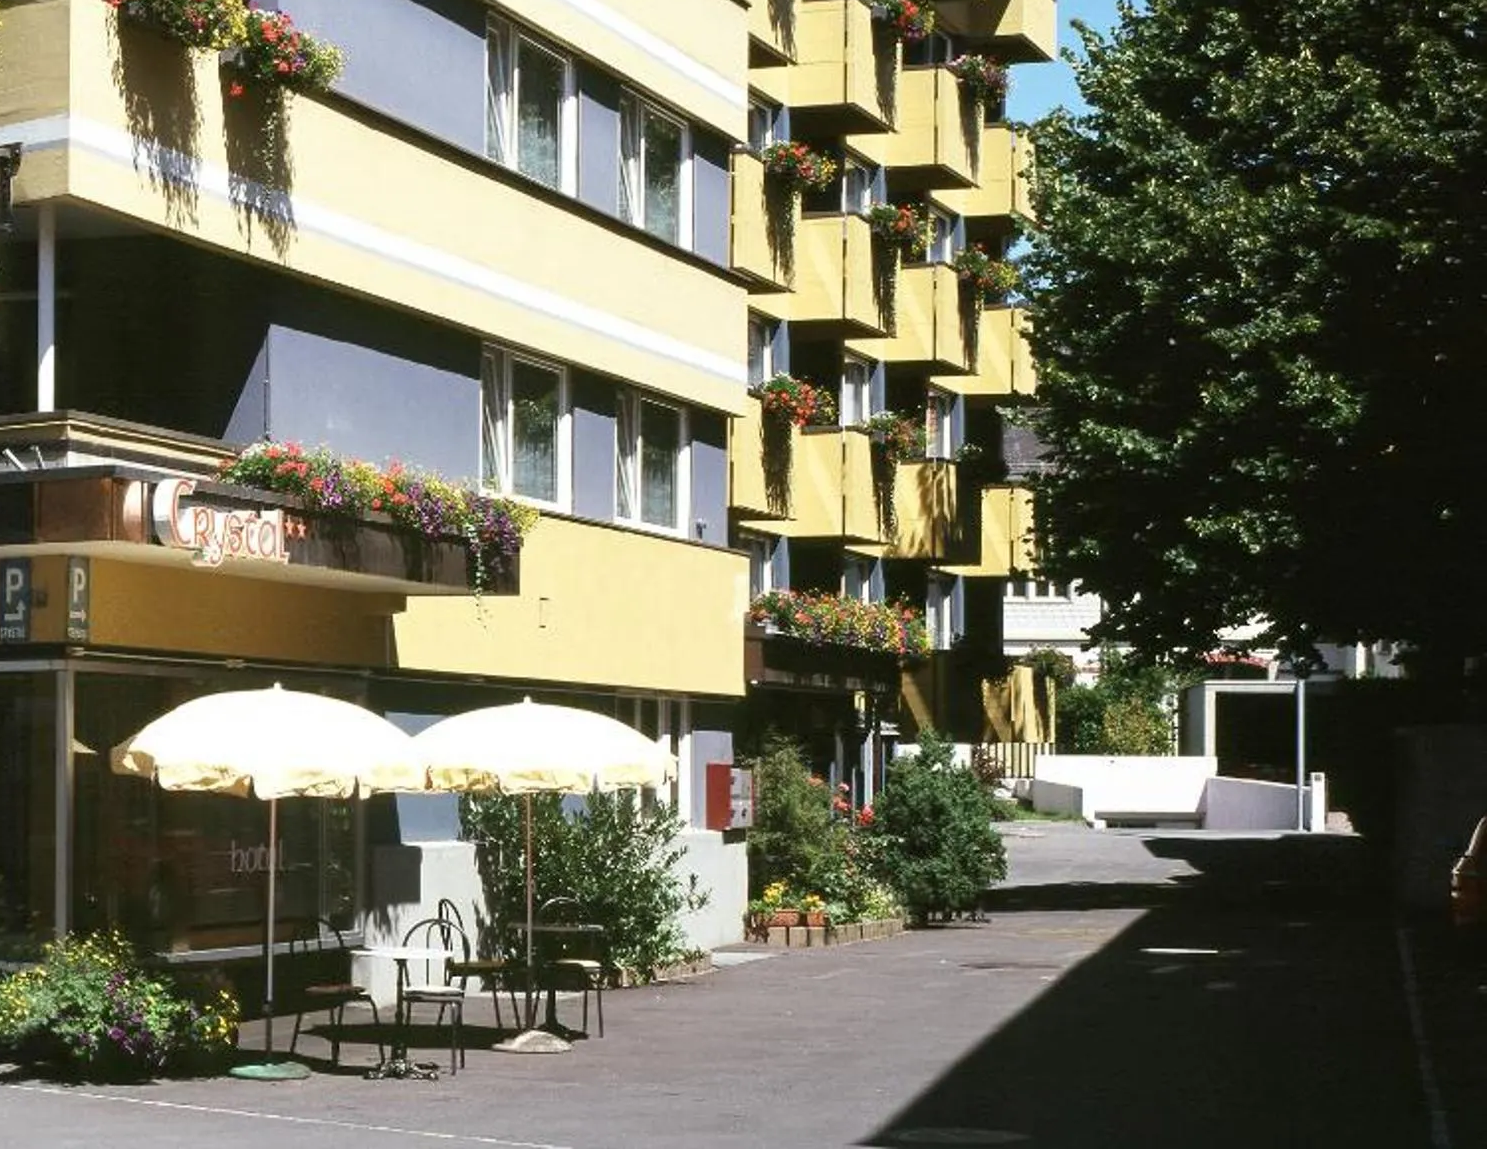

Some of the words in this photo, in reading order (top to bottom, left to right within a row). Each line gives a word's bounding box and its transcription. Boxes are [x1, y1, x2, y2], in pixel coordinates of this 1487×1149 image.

[5, 567, 25, 604] P
[73, 567, 87, 603] P
[231, 838, 285, 874] hotl
